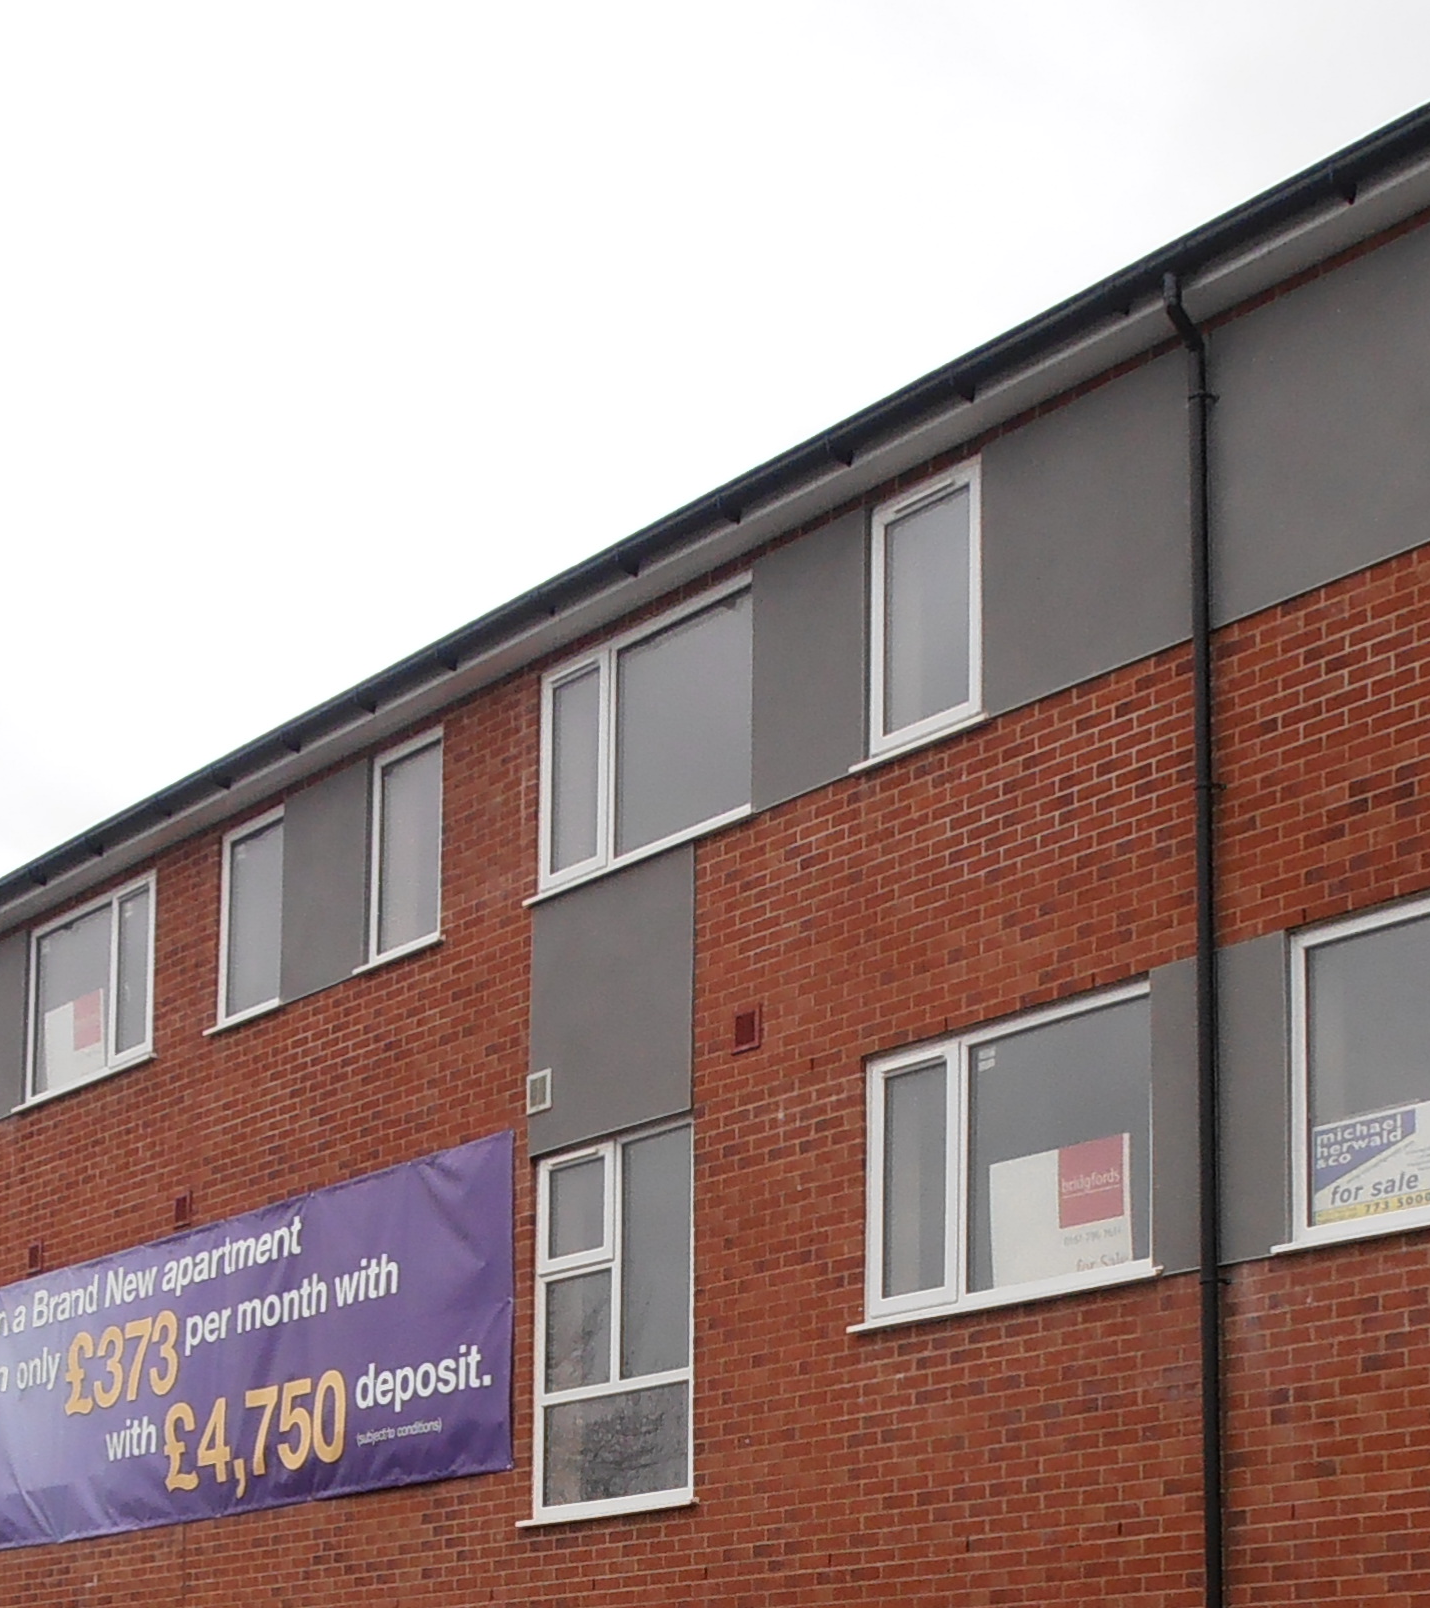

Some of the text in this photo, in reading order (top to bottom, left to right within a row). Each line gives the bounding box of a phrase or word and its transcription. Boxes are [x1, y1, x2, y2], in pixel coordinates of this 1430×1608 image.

[1316, 1114, 1402, 1144] michael
[1316, 1128, 1402, 1158] herwald
[1331, 1171, 1419, 1205] for sale
[1364, 1201, 1389, 1214] 773
[12, 1305, 26, 1333] a
[32, 1274, 99, 1329] Brand
[104, 1267, 157, 1308] New
[161, 1216, 302, 1297] apartment
[16, 1346, 61, 1390] only
[64, 1310, 178, 1415] £373
[185, 1308, 231, 1356] per
[236, 1273, 327, 1333] month
[335, 1254, 398, 1307] with
[105, 1344, 492, 1499] with £4,750 deposit.
